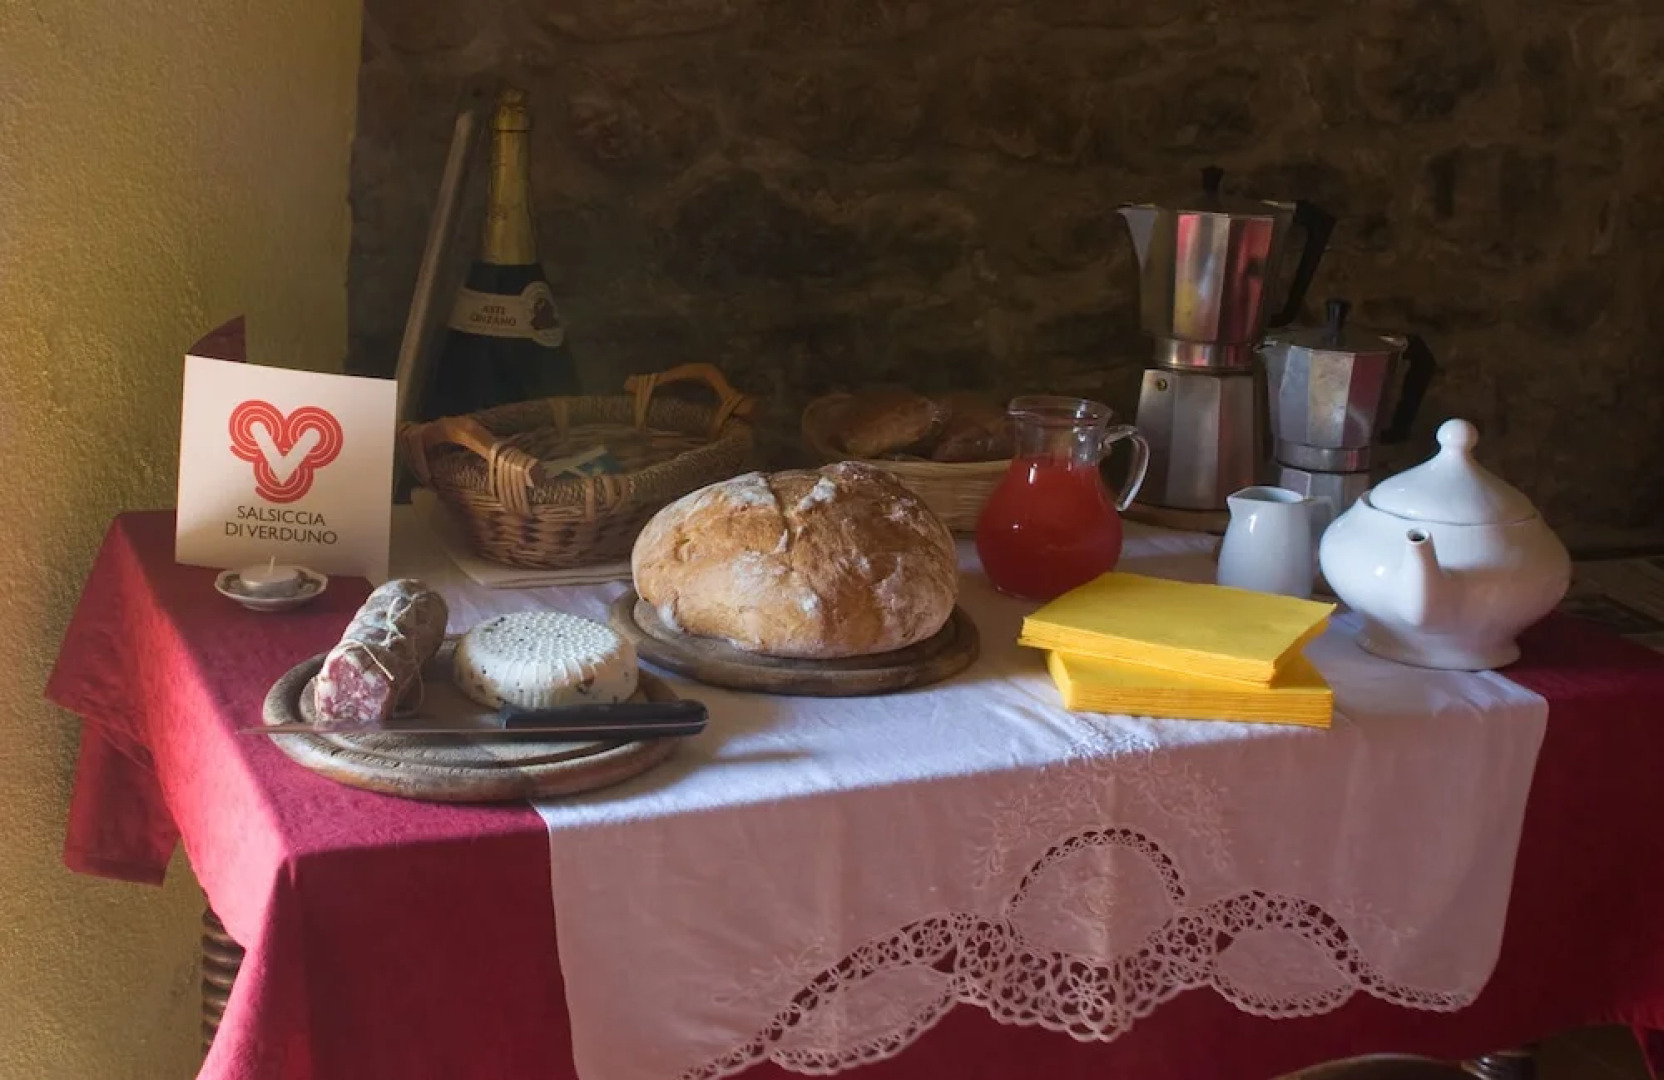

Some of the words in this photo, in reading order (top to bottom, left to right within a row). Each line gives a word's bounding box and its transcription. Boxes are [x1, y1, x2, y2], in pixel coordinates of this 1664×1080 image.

[481, 305, 507, 314] ASTI
[237, 505, 326, 526] SALSICCIA
[226, 522, 244, 537] DI
[247, 525, 338, 545] VERDUNO
